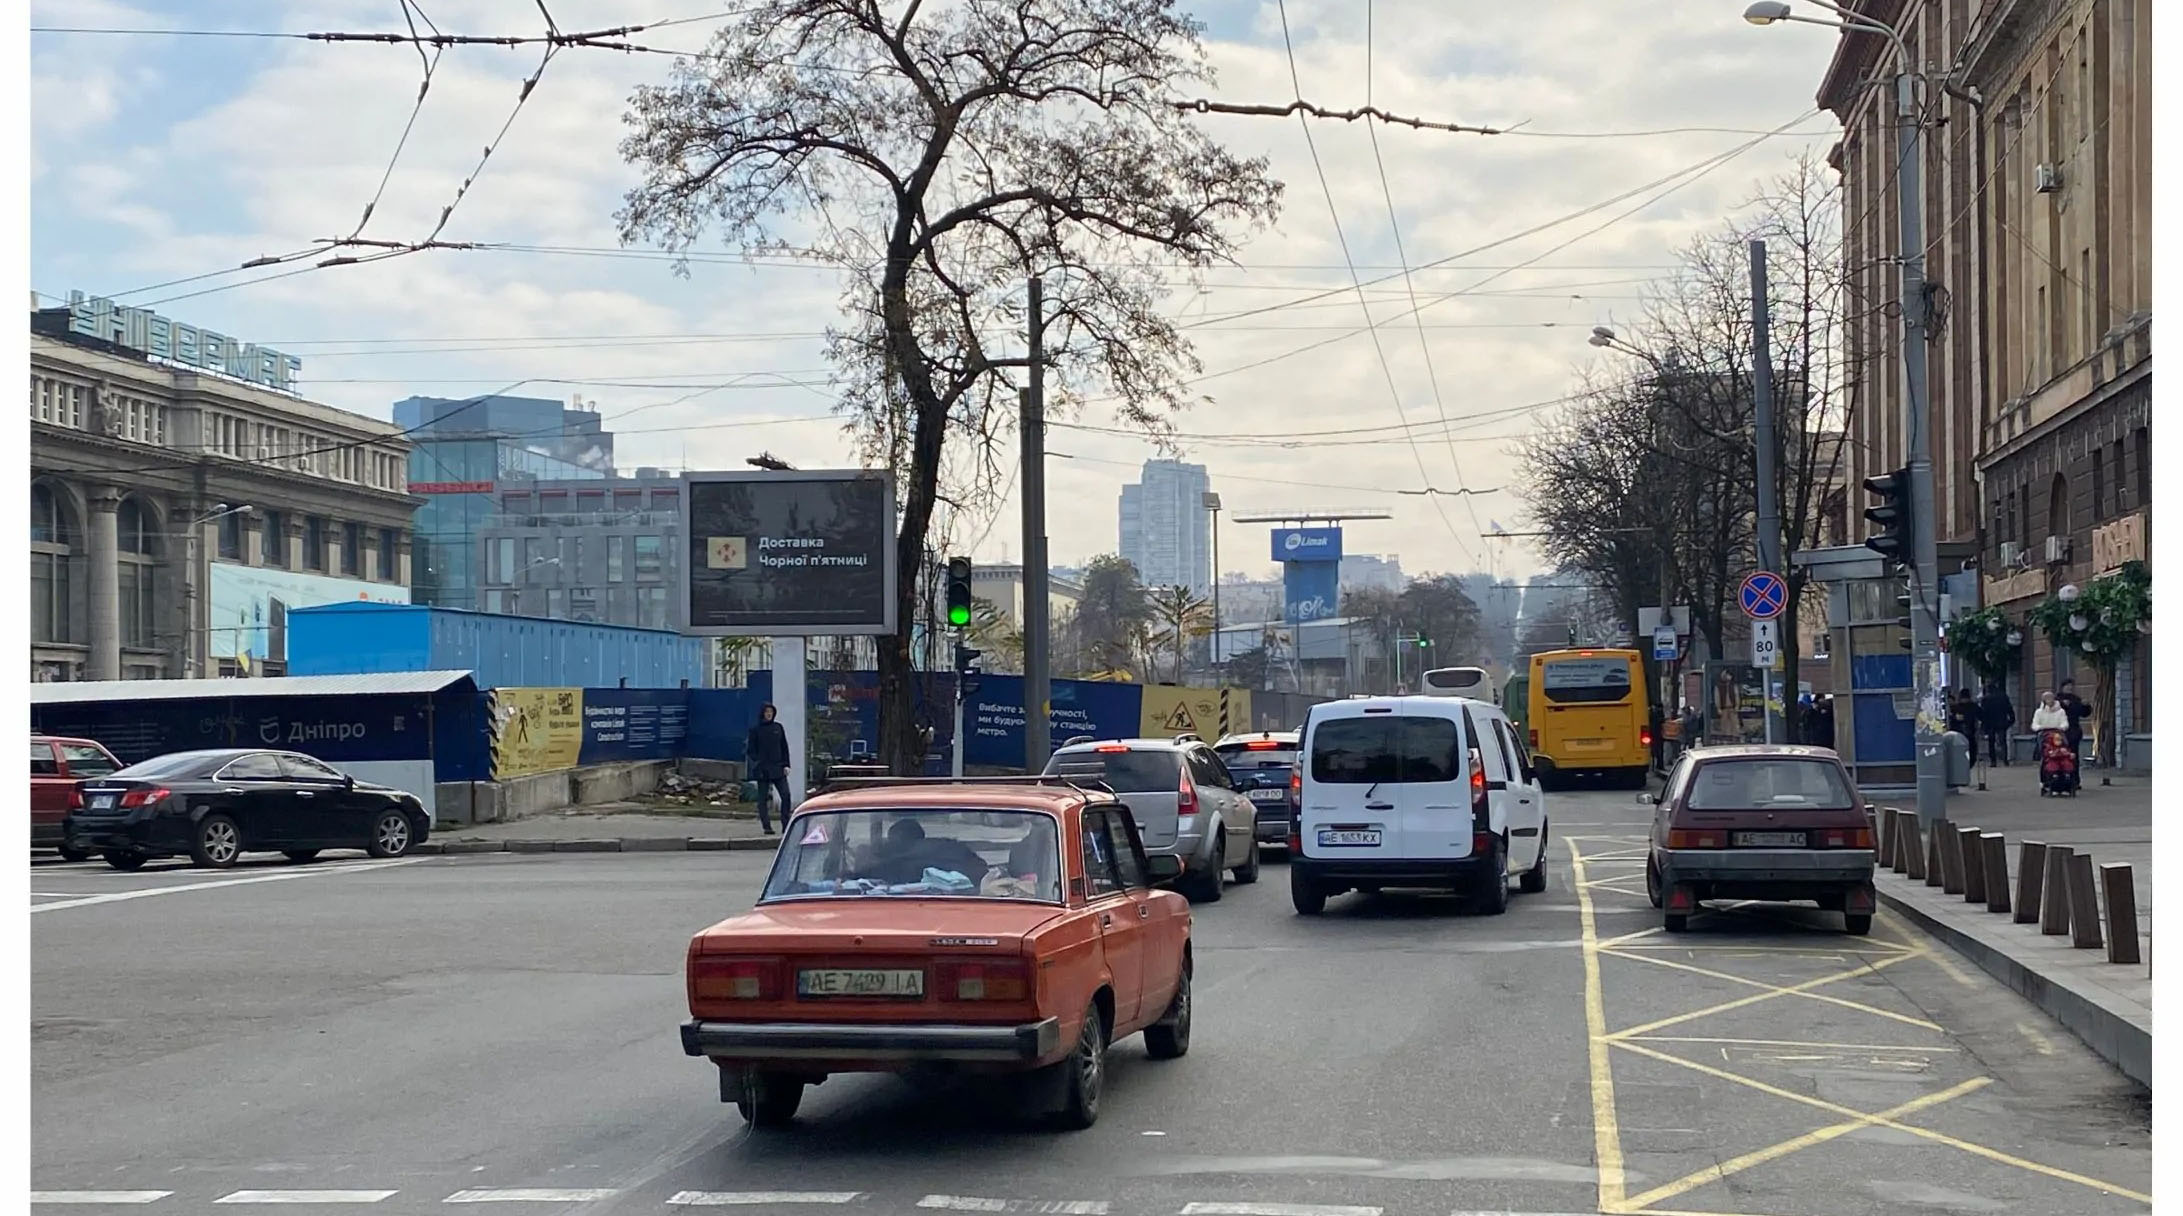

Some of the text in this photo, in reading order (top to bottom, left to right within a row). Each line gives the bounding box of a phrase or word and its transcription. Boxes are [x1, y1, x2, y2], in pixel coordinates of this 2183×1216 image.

[758, 537, 824, 549] Доставка
[1301, 536, 1328, 546] Limak
[759, 553, 867, 568] Чорної п'ятниці
[1756, 641, 1774, 653] 80
[978, 703, 1016, 714] Вибачте
[978, 715, 992, 723] ми
[1060, 720, 1097, 731] станцію
[288, 720, 366, 743] Дніпро
[976, 727, 1008, 737] метро.
[810, 972, 838, 992] AE
